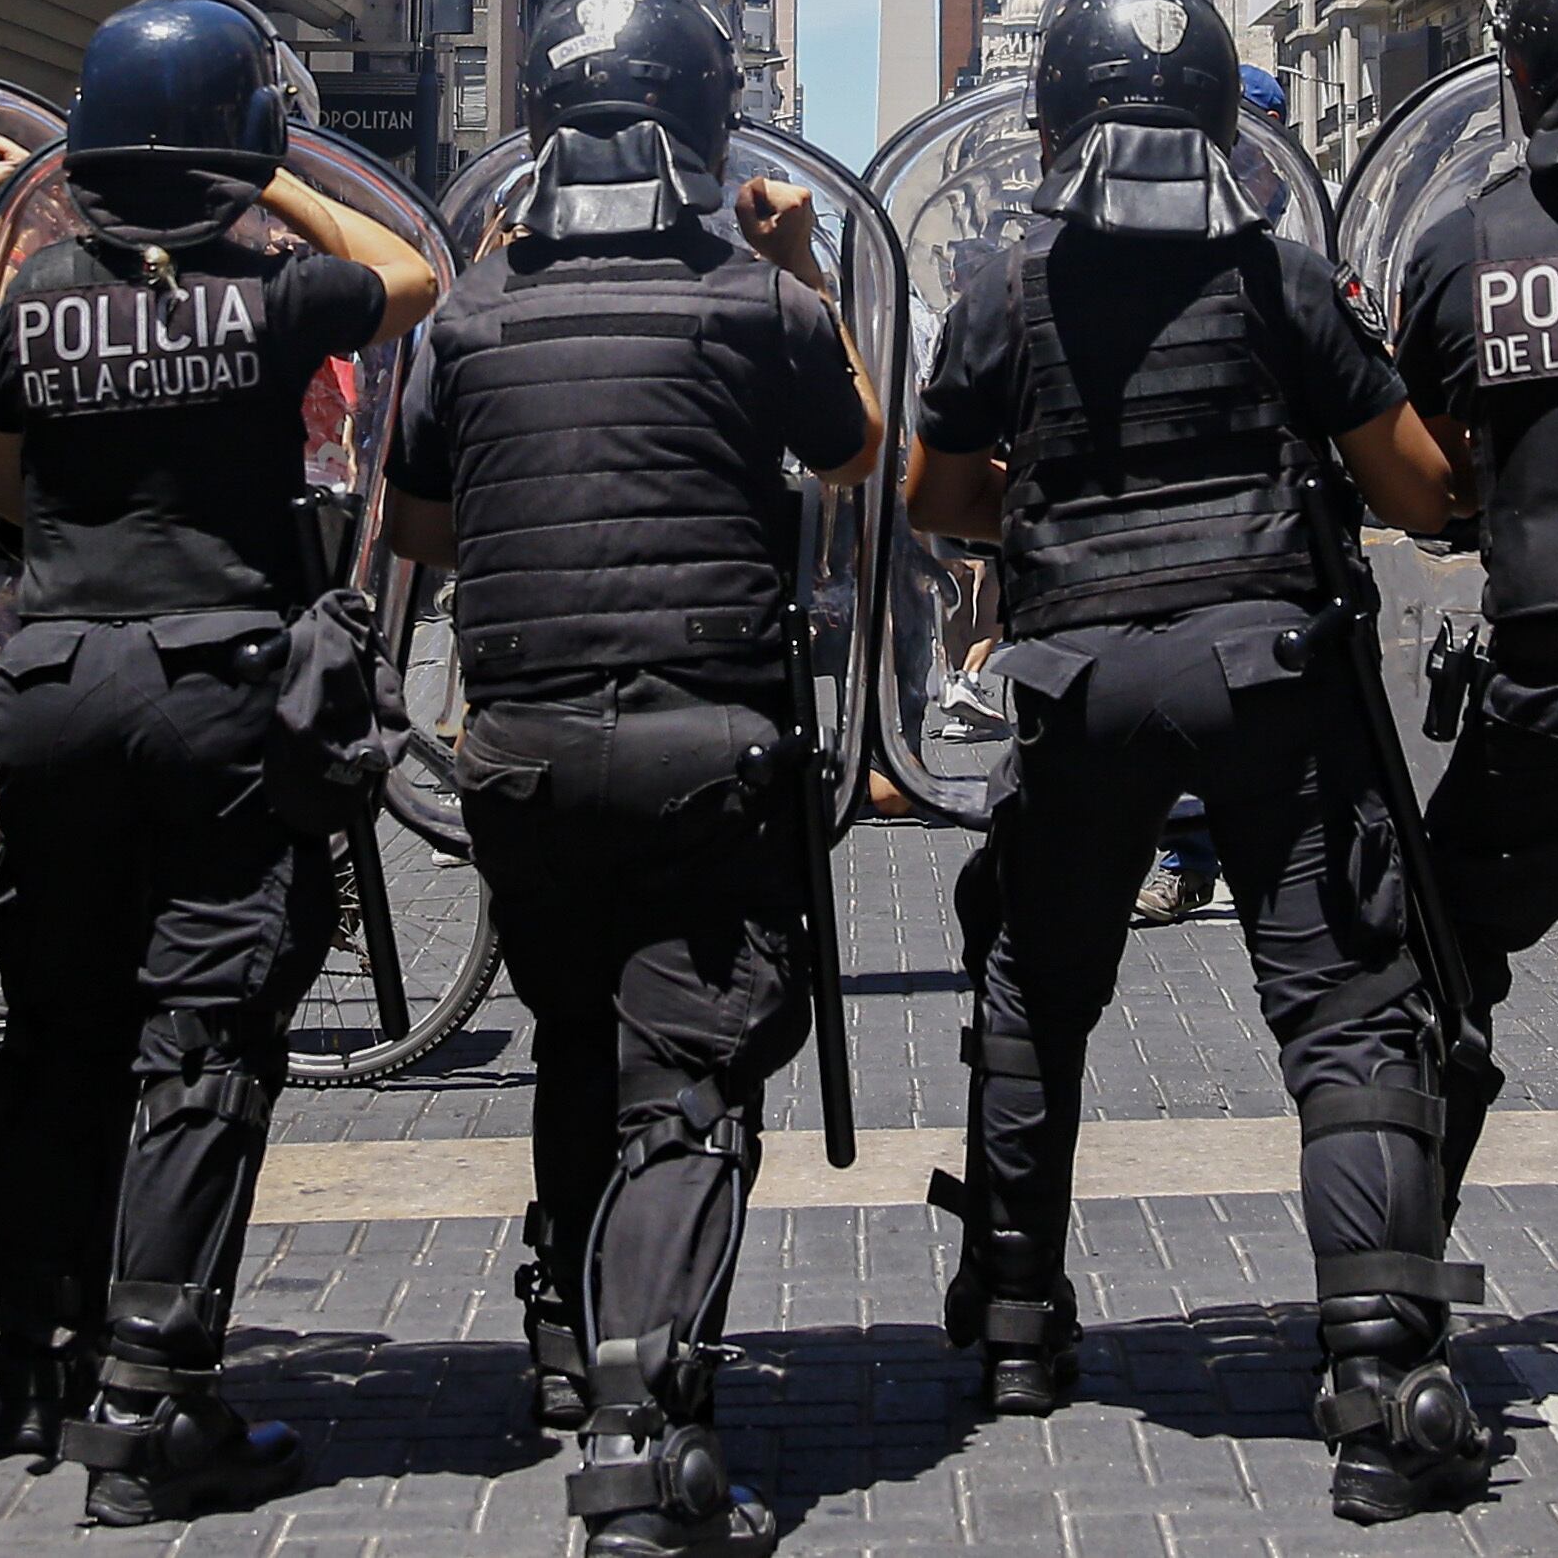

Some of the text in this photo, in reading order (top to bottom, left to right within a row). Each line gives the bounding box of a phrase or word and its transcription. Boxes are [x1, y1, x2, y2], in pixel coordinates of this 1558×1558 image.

[18, 284, 257, 365] POLICIA
[23, 351, 261, 409] DE LA CIUDAD
[1484, 334, 1531, 377] DE
